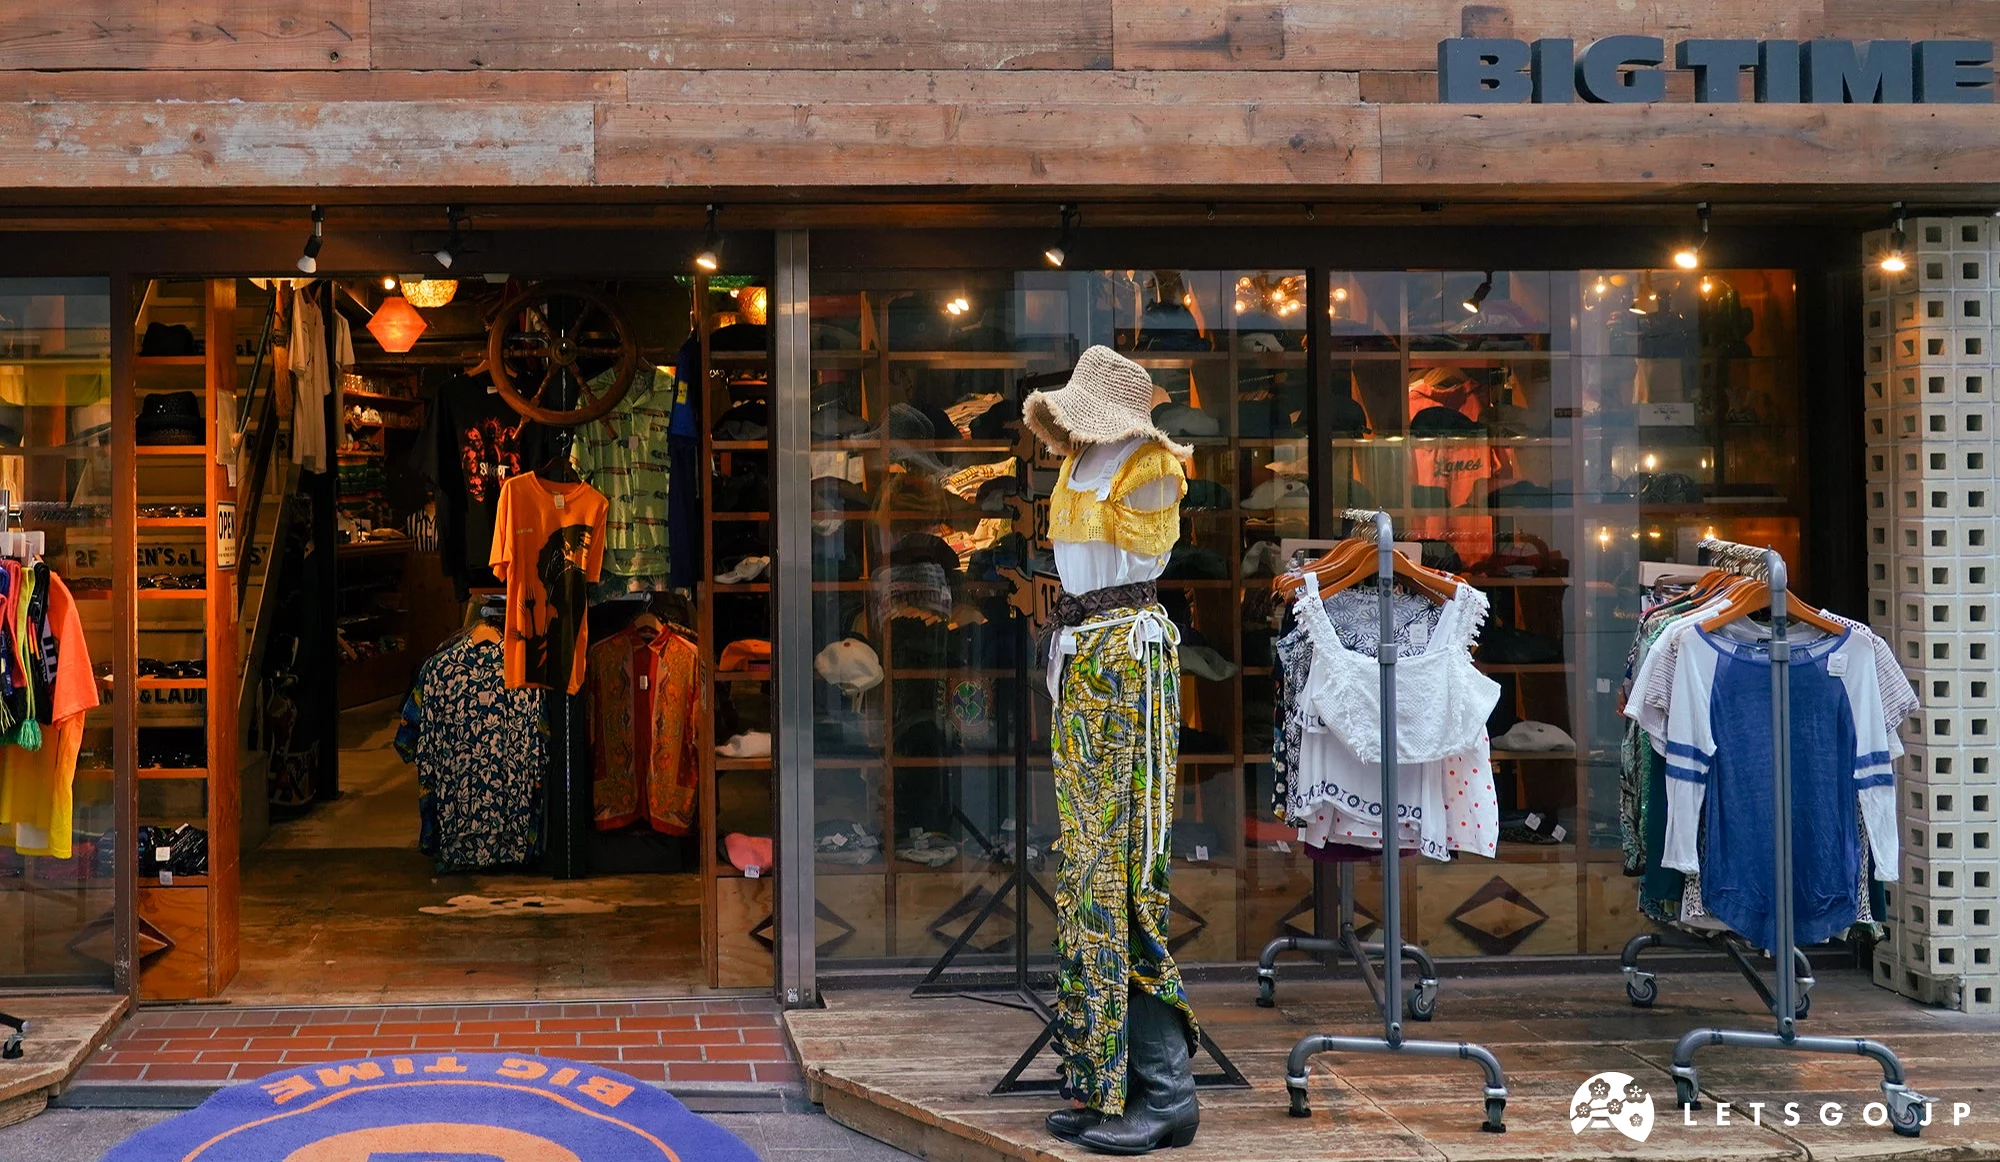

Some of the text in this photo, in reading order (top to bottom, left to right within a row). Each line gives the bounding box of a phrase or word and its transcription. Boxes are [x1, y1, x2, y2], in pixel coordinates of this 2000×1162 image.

[1437, 35, 1994, 103] BIG TIME
[218, 510, 236, 539] OPEN
[75, 549, 98, 568] 2F
[260, 1056, 635, 1108] BIG TIME
